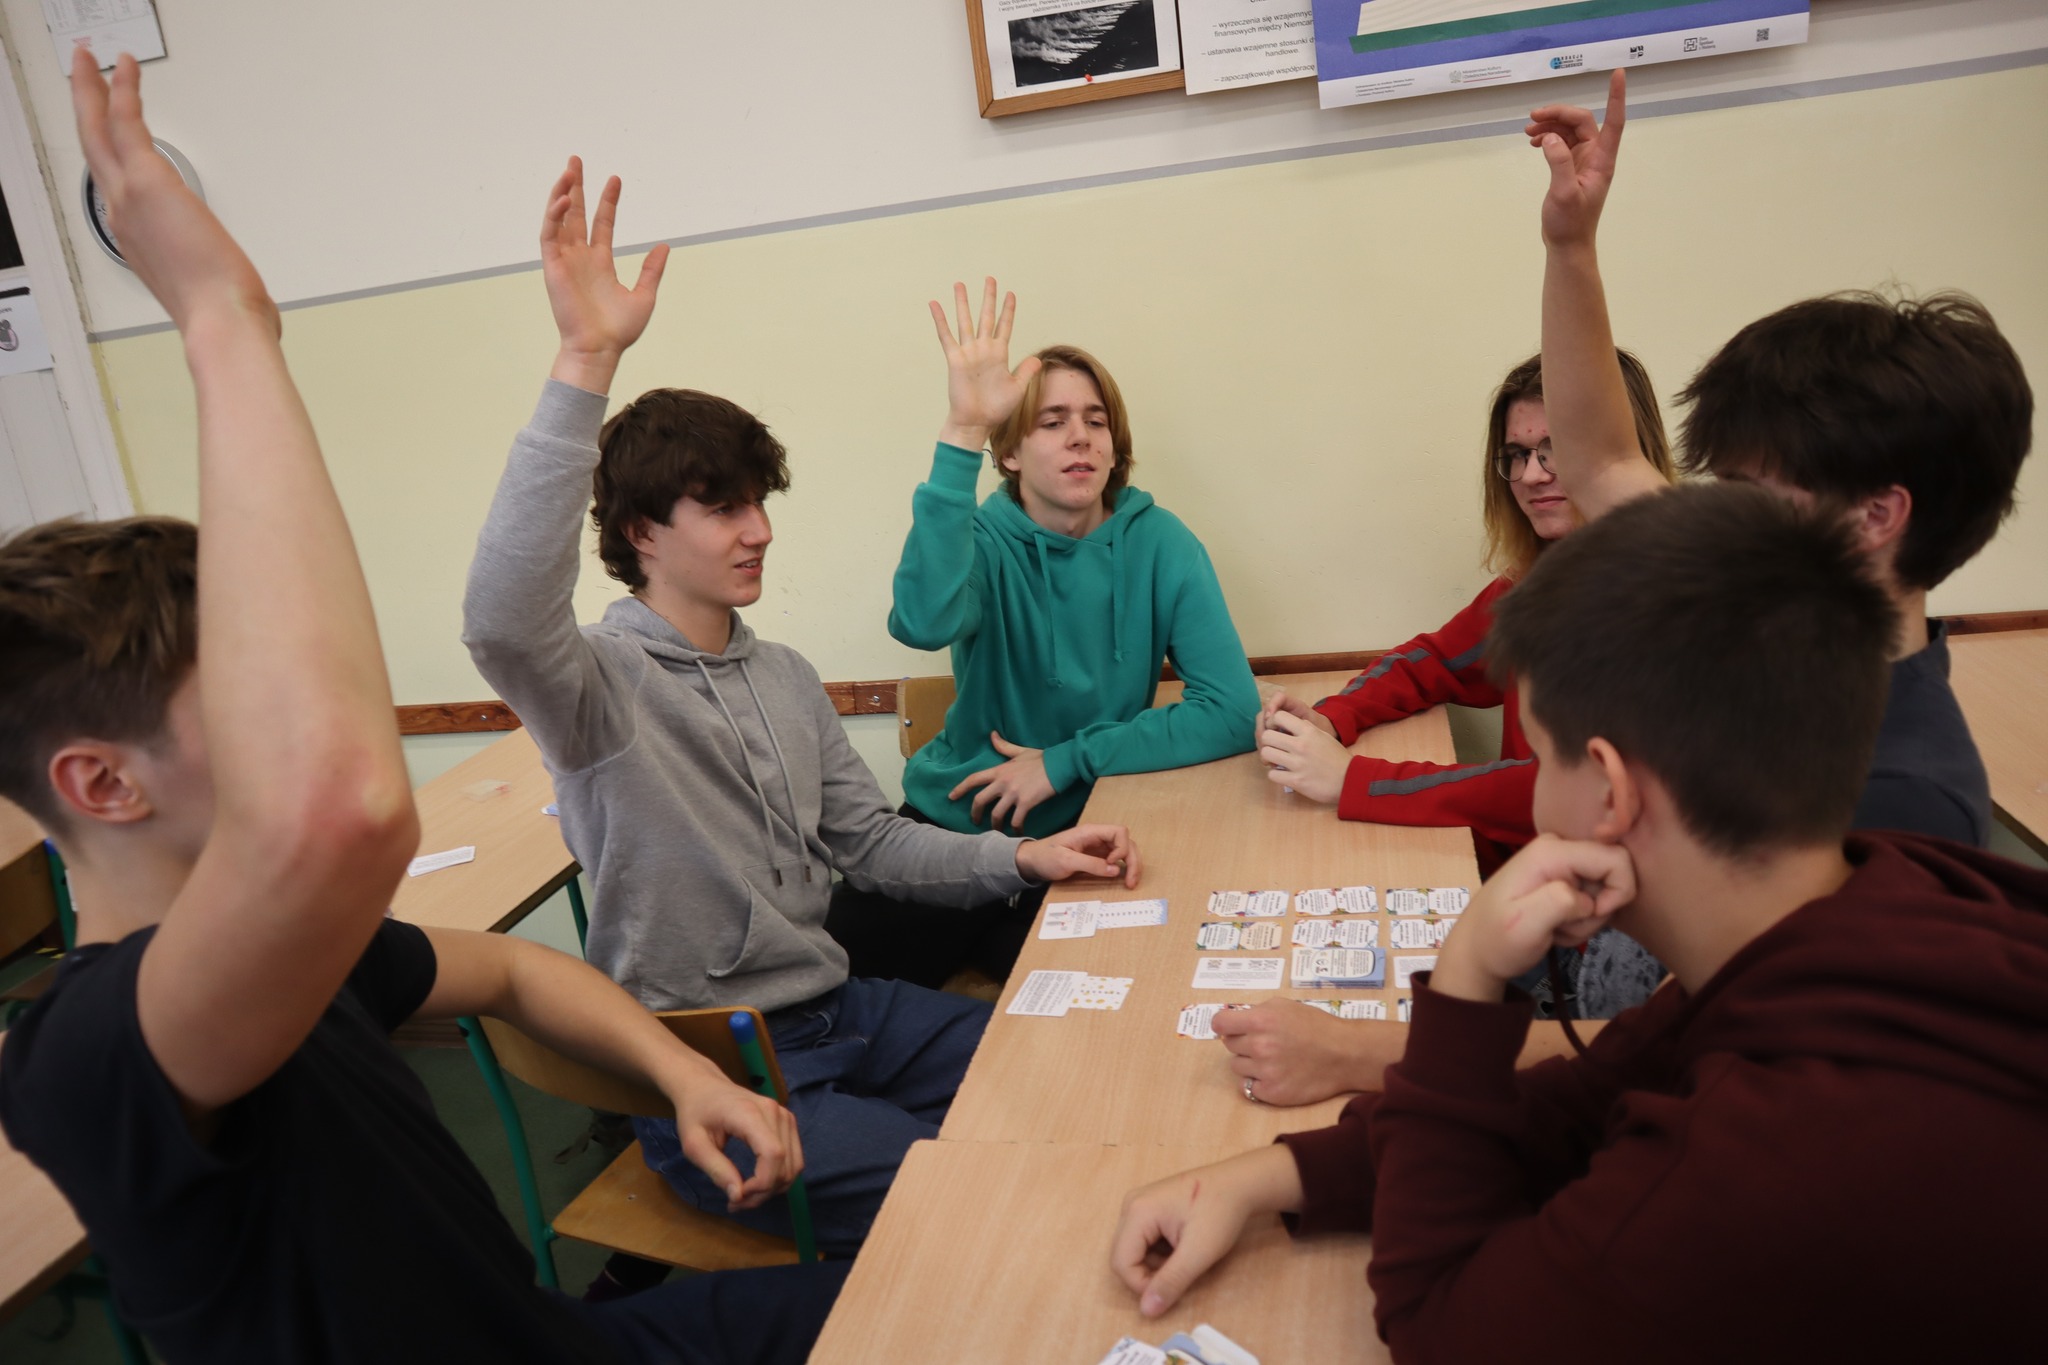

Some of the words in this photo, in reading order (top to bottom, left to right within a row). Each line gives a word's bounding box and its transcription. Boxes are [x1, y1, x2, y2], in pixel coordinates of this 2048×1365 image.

[1218, 17, 1260, 28] wyrzeczenia
[1273, 10, 1312, 21] wzajemnyc
[1214, 27, 1256, 37] finansowych
[1258, 22, 1281, 32] między
[1207, 47, 1241, 56] ustanawia
[1243, 42, 1277, 52] wzajemne
[1279, 38, 1307, 47] stosunki
[1220, 70, 1274, 82] zapoczątkowuje
